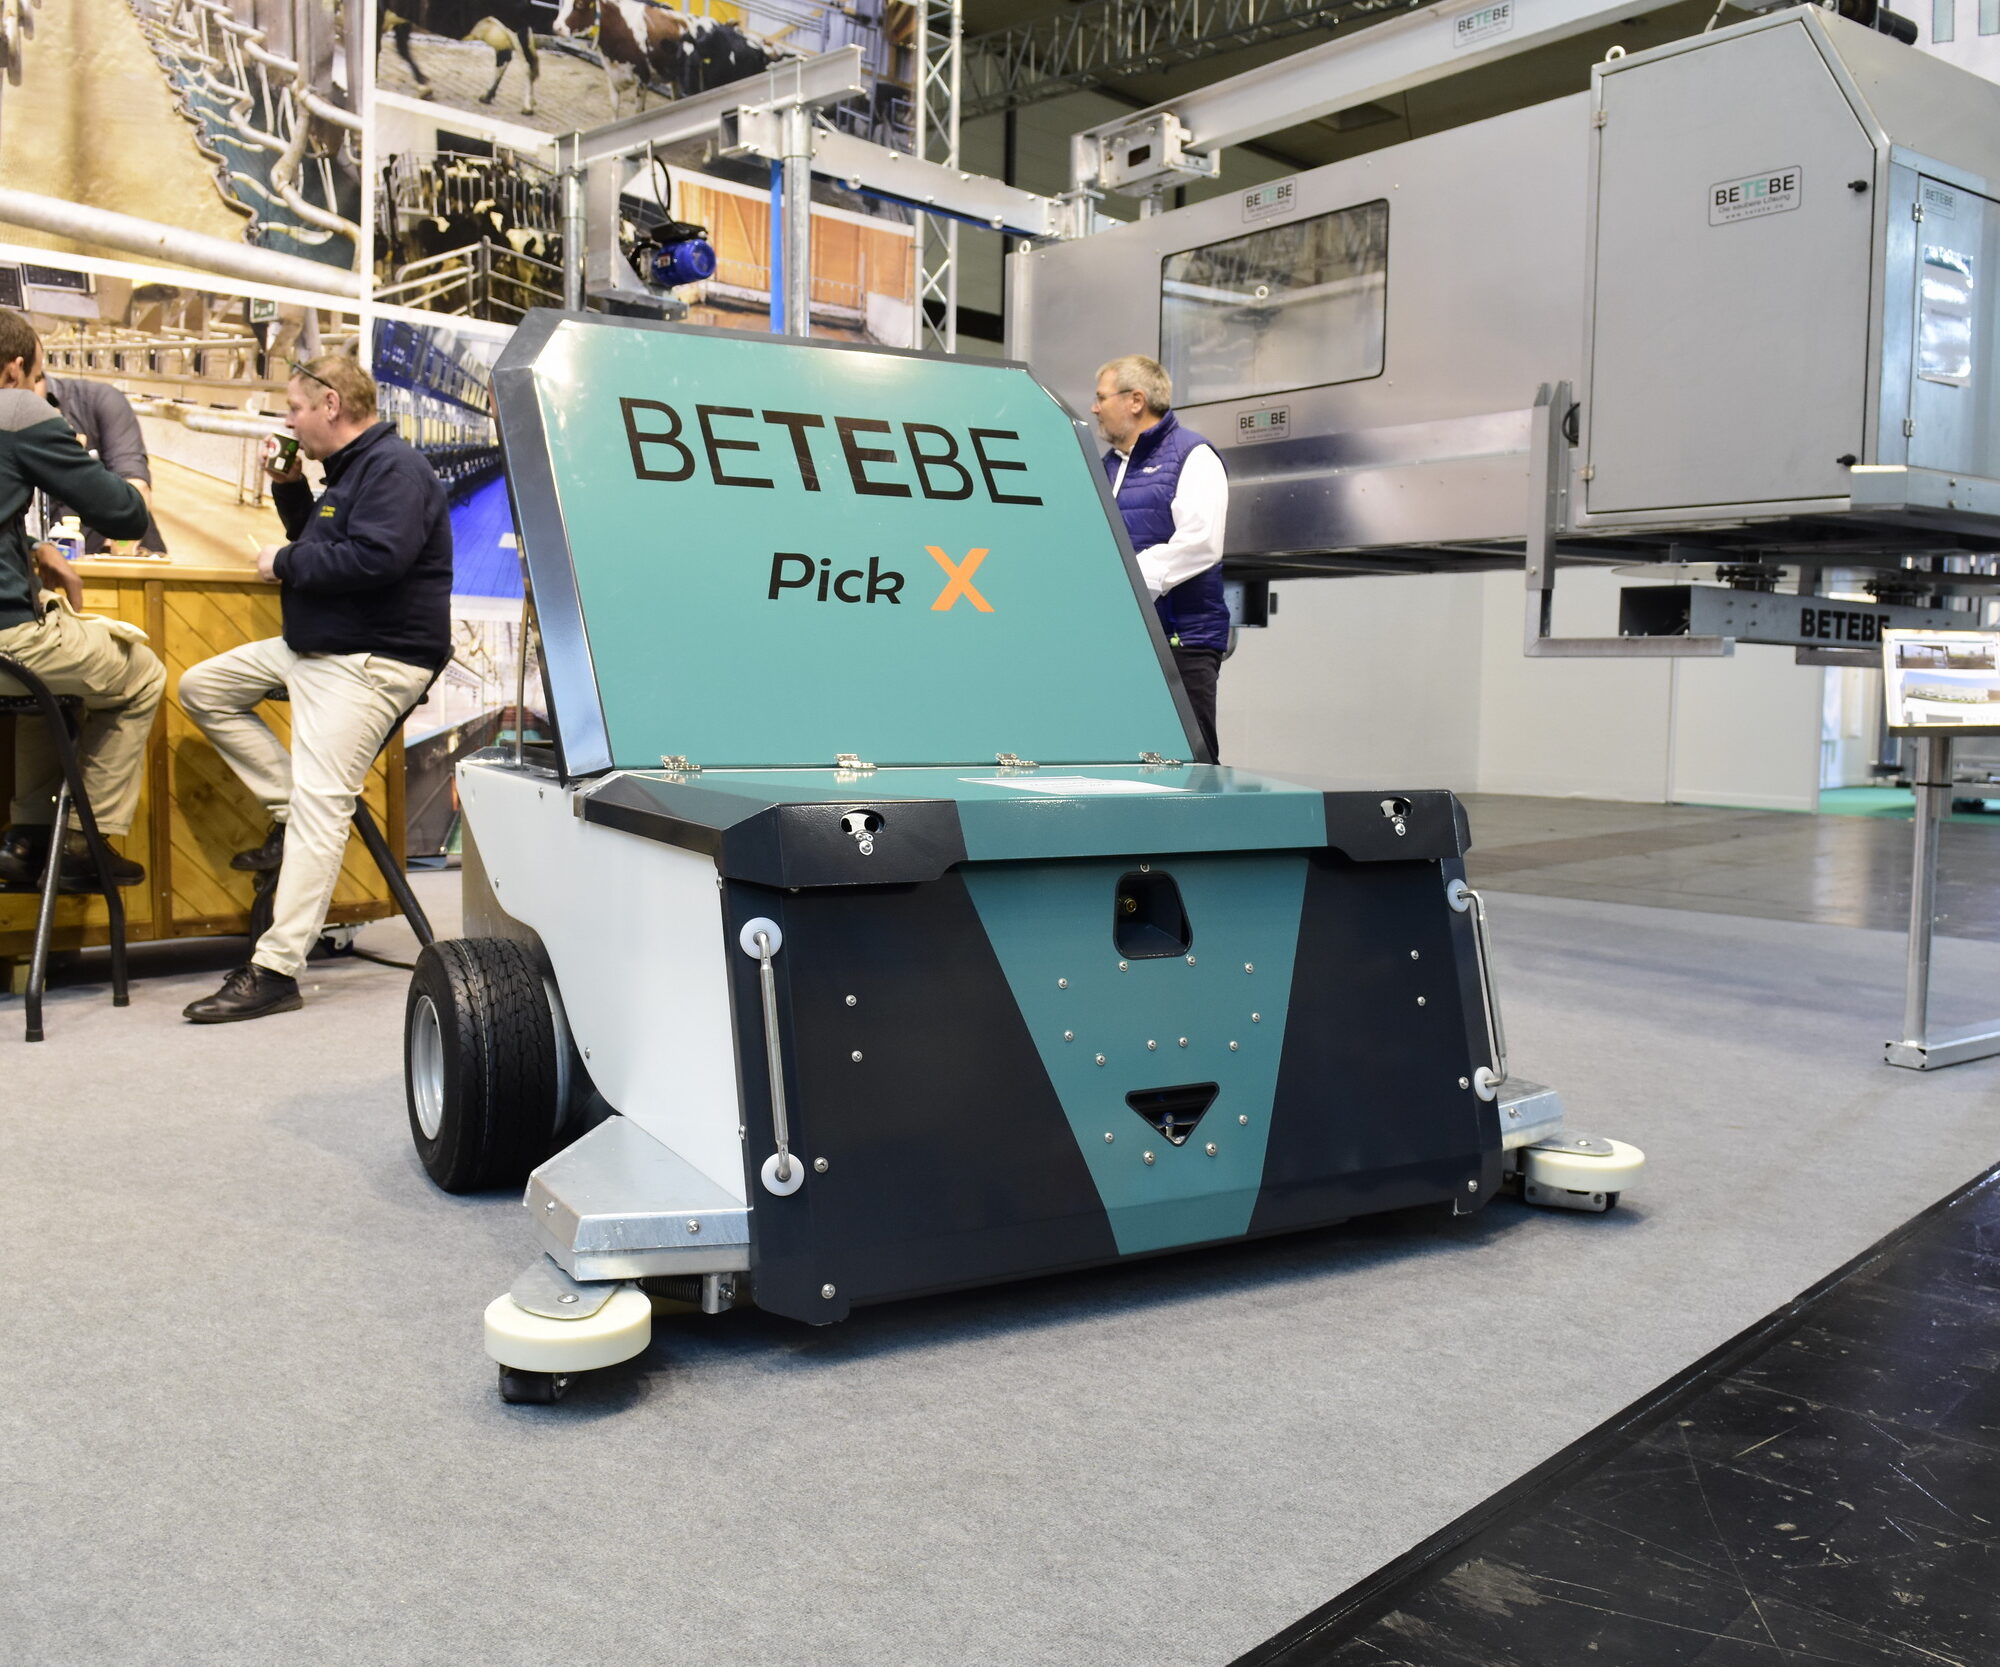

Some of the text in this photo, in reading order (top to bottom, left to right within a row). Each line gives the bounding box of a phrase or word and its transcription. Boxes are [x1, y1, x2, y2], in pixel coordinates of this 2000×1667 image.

[1458, 5, 1509, 32] BETEBE
[1246, 183, 1293, 208] BETEBE
[1716, 174, 1795, 206] BETEBE
[1240, 411, 1286, 429] BETEBE
[618, 396, 1044, 506] BETEBE
[767, 545, 995, 613] Pick X
